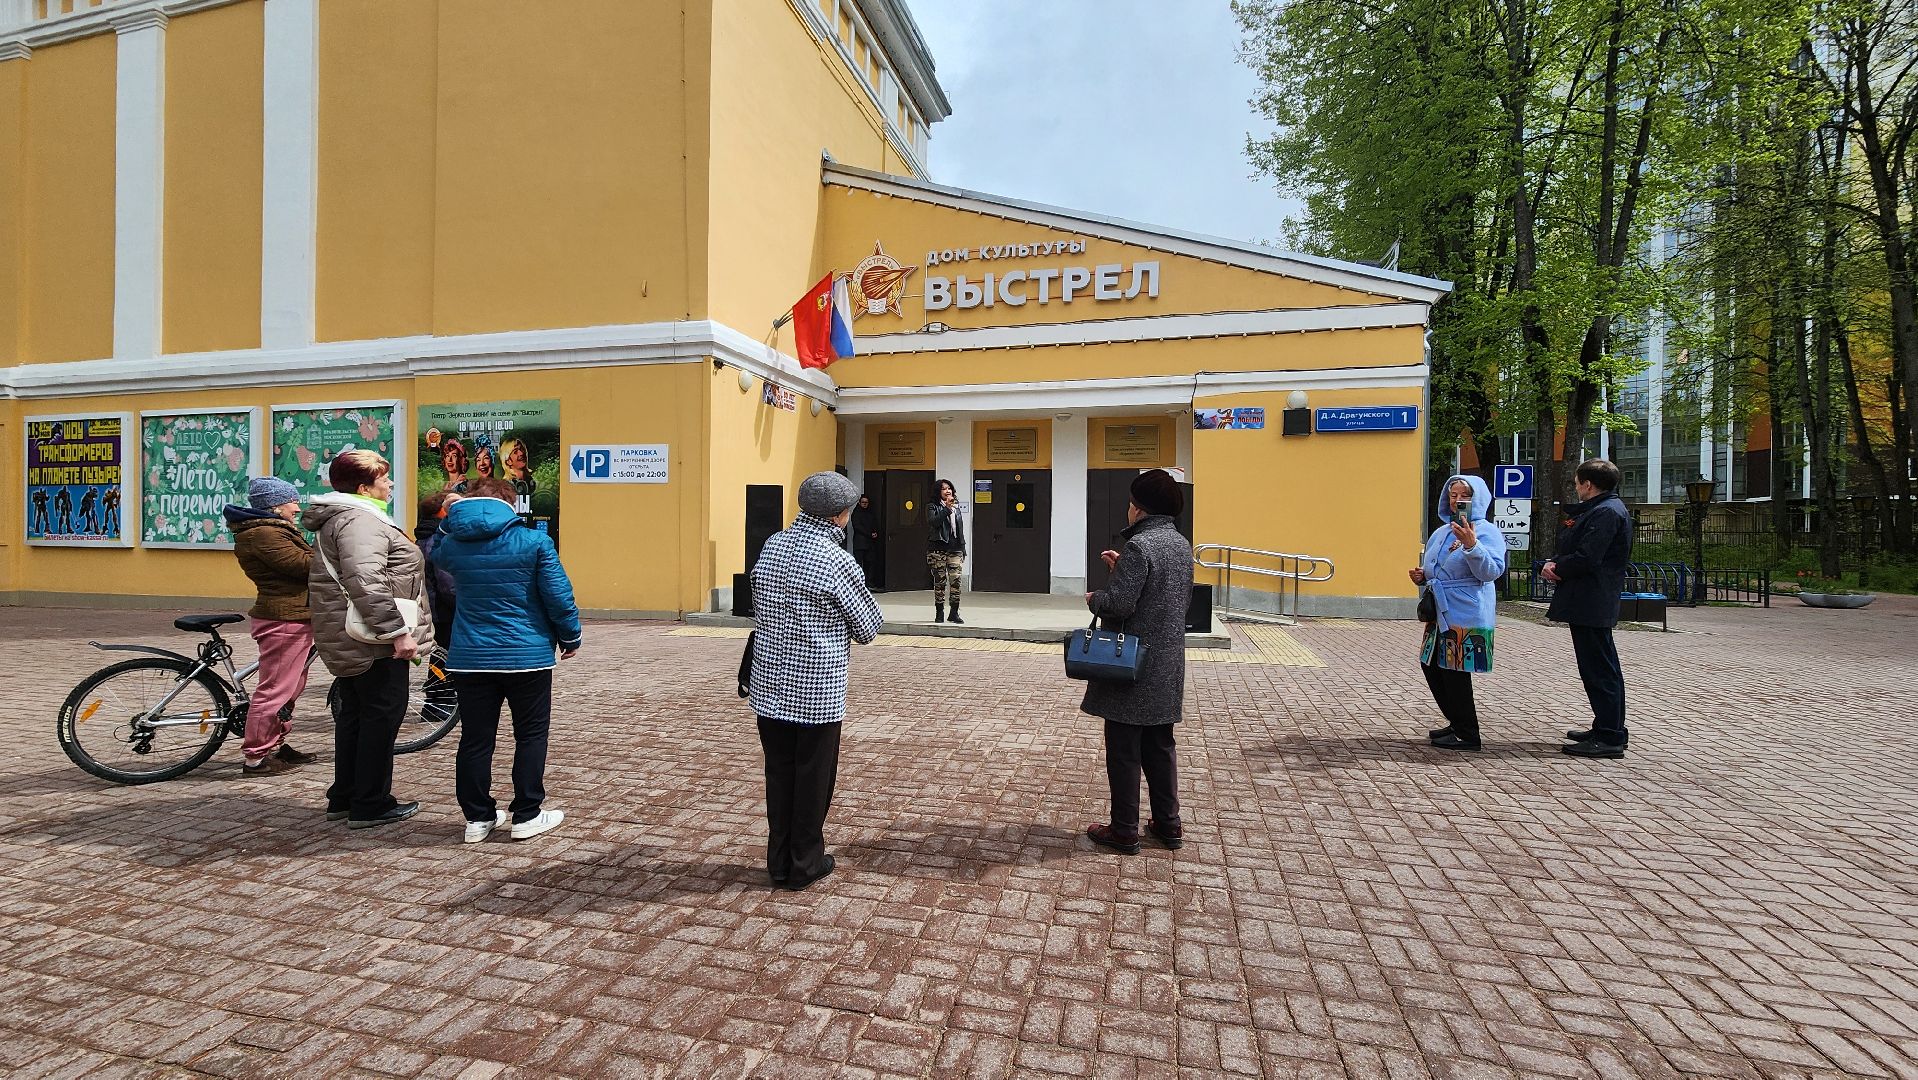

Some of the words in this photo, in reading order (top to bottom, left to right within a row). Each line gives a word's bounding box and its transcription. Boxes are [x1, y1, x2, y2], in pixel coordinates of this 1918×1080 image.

[926, 247, 969, 266] ДОМ
[979, 239, 1086, 260] КУЛЬТУРЫ
[924, 261, 1159, 310] ВЫСТРЕЛ
[460, 421, 467, 432] 18
[469, 421, 485, 431] МАЯ
[1401, 411, 1408, 424] 1
[64, 421, 84, 440] ШОУ
[176, 432, 202, 445] ЛЕТО
[38, 443, 113, 463] ТРАНСФОРМЕРОВ
[29, 467, 39, 485] НА
[43, 466, 80, 485] ПЛАНЕТЕ
[172, 464, 217, 490] Лето
[1496, 520, 1506, 529] 10
[62, 705, 72, 743] MERIDA
